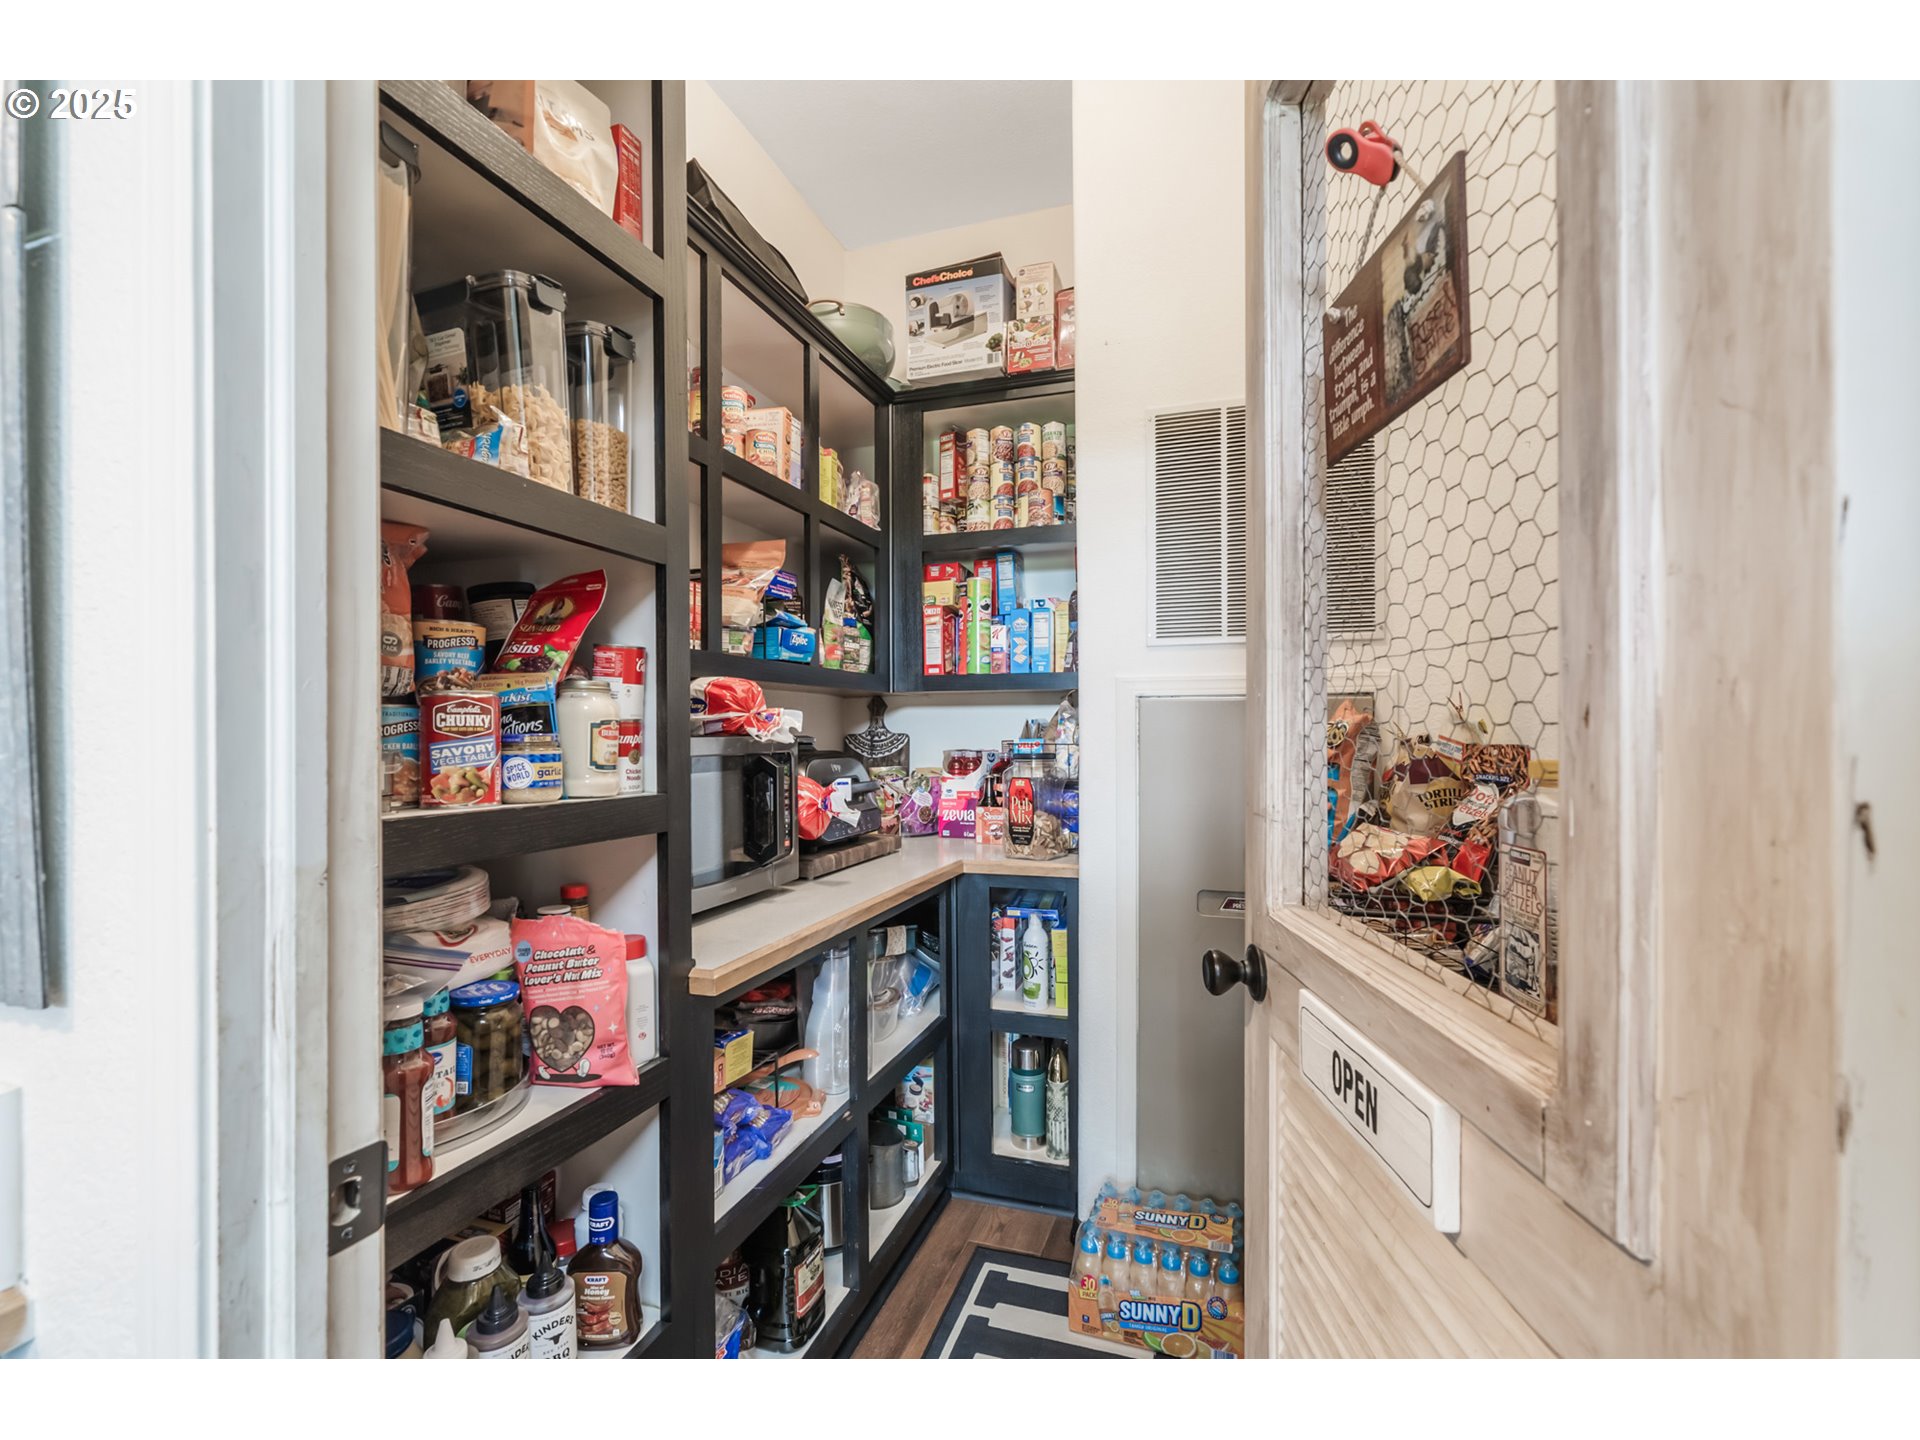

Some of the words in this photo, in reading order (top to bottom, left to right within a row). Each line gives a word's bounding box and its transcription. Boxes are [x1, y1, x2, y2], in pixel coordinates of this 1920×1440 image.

[1344, 304, 1358, 328] The
[1328, 318, 1365, 365] difference
[1333, 339, 1365, 380] between
[1334, 368, 1357, 399] trying
[1358, 347, 1374, 377] and
[1360, 377, 1369, 396] is
[1370, 371, 1376, 388] a
[1332, 415, 1350, 440] little
[427, 637, 476, 648] PROGRESSO
[436, 712, 490, 728] CHUNKY
[432, 742, 494, 759] SAVORY
[432, 752, 496, 766] VEGETABLE
[506, 762, 526, 772] SPICE
[506, 770, 531, 782] WORLD
[1012, 796, 1032, 812] Pub
[942, 809, 975, 821] zevia
[1011, 809, 1032, 824] Mix
[469, 946, 512, 964] EVERYDAY
[534, 946, 586, 960] Chocolate
[587, 944, 596, 954] &
[525, 962, 565, 974] Peanut
[566, 957, 600, 970] Butter
[524, 974, 561, 986] Lover's
[564, 972, 580, 982] Nut
[580, 968, 603, 980] Mix
[1332, 1049, 1378, 1136] OPEN
[1082, 1276, 1096, 1290] 30
[584, 1288, 610, 1296] Honey
[1120, 1301, 1201, 1331] SUNNYD
